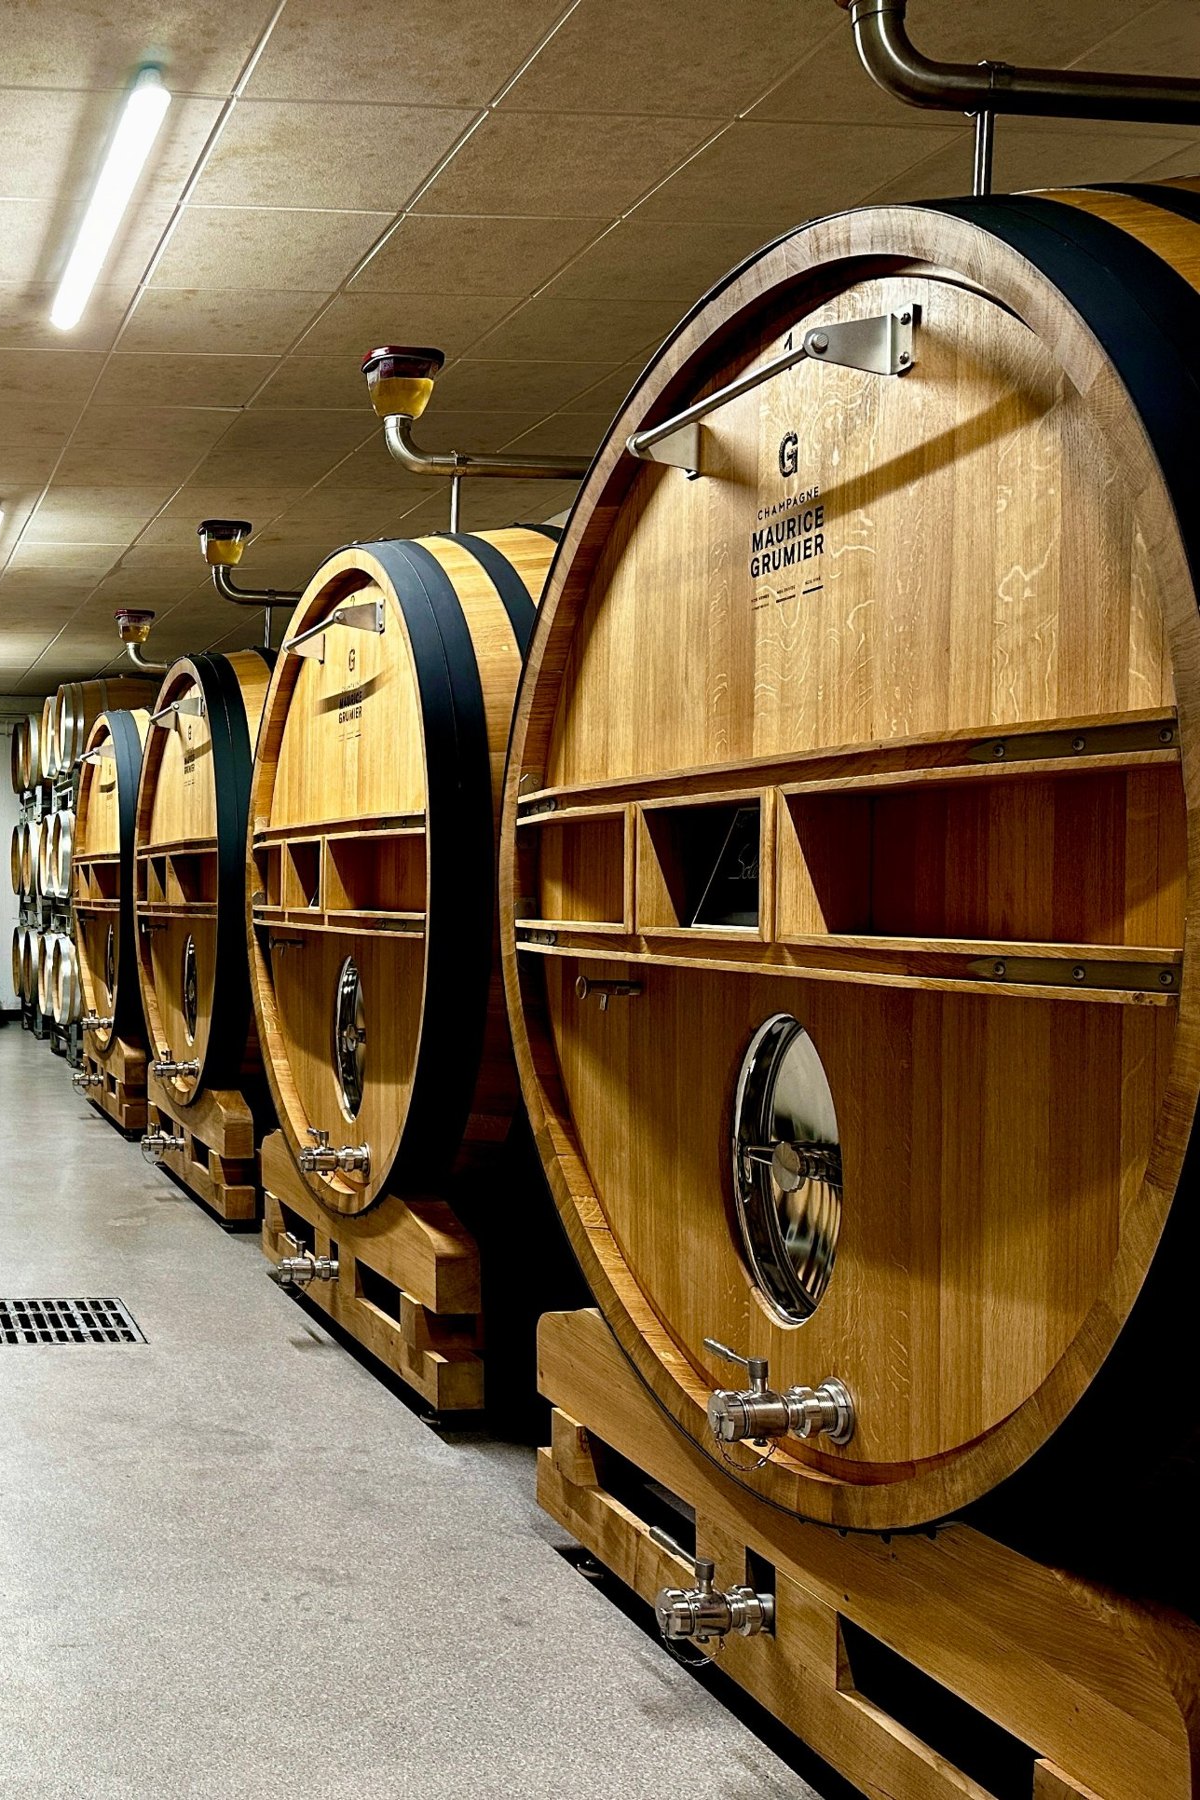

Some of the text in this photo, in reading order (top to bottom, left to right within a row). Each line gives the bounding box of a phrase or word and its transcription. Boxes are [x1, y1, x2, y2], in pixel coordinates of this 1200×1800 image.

[779, 431, 798, 477] G
[757, 486, 820, 521] CHAMPAGNE
[751, 505, 824, 553] MAURICE
[751, 533, 824, 578] GRUMIER
[339, 706, 362, 723] GRUMIER
